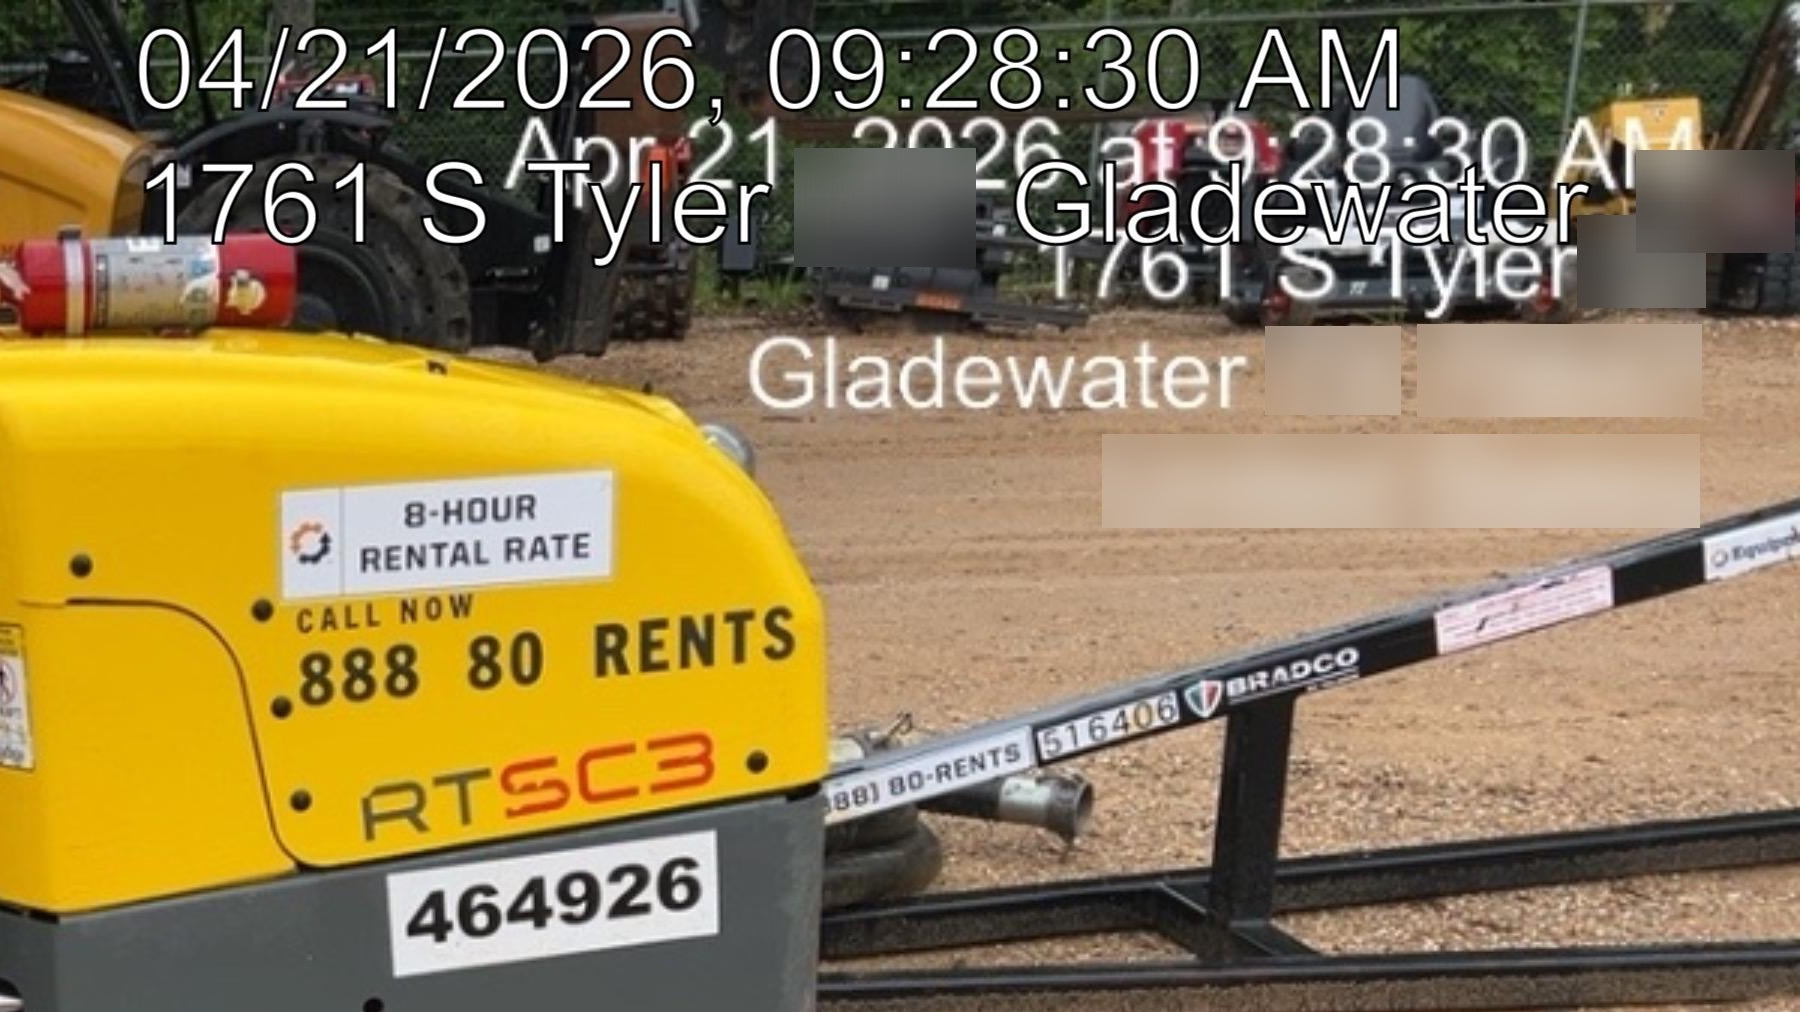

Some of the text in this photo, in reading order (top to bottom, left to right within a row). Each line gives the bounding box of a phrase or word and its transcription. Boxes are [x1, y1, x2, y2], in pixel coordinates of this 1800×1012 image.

[403, 494, 537, 529] 8-HOUR
[360, 532, 592, 574] RENTAL RATE
[296, 593, 475, 633] CALL NOW
[299, 606, 797, 707] 888 80 RENTS
[1226, 647, 1360, 697] BRADCO
[1043, 695, 1176, 755] 516406
[825, 743, 1022, 813] 88) 80-RENTS
[406, 857, 703, 943] 464926
